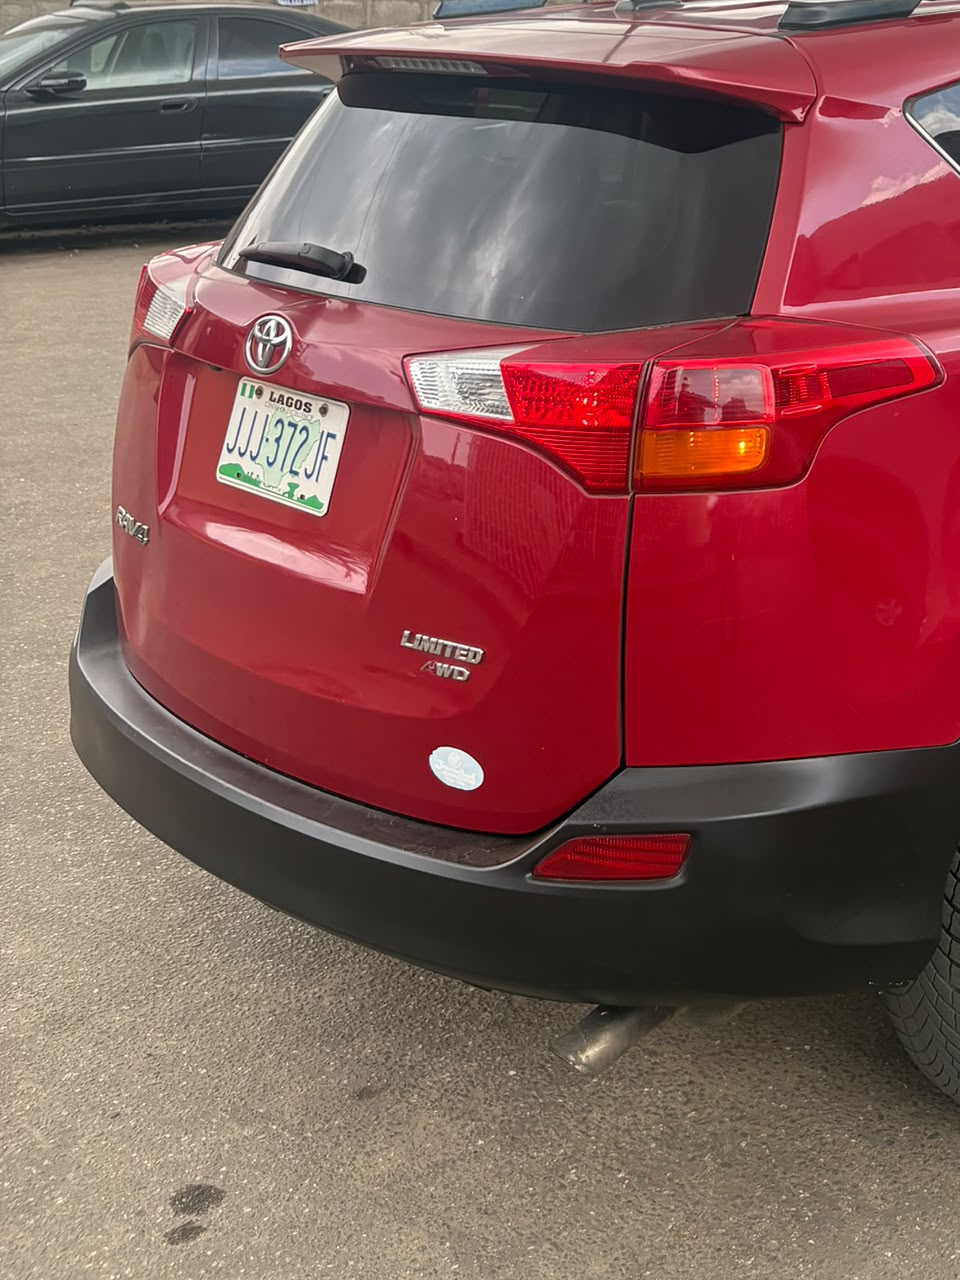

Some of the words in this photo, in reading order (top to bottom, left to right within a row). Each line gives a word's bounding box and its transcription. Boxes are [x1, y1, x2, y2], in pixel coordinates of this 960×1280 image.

[269, 391, 313, 413] LAGOS
[400, 629, 484, 665] LIMITED
[420, 660, 470, 682] AWD
